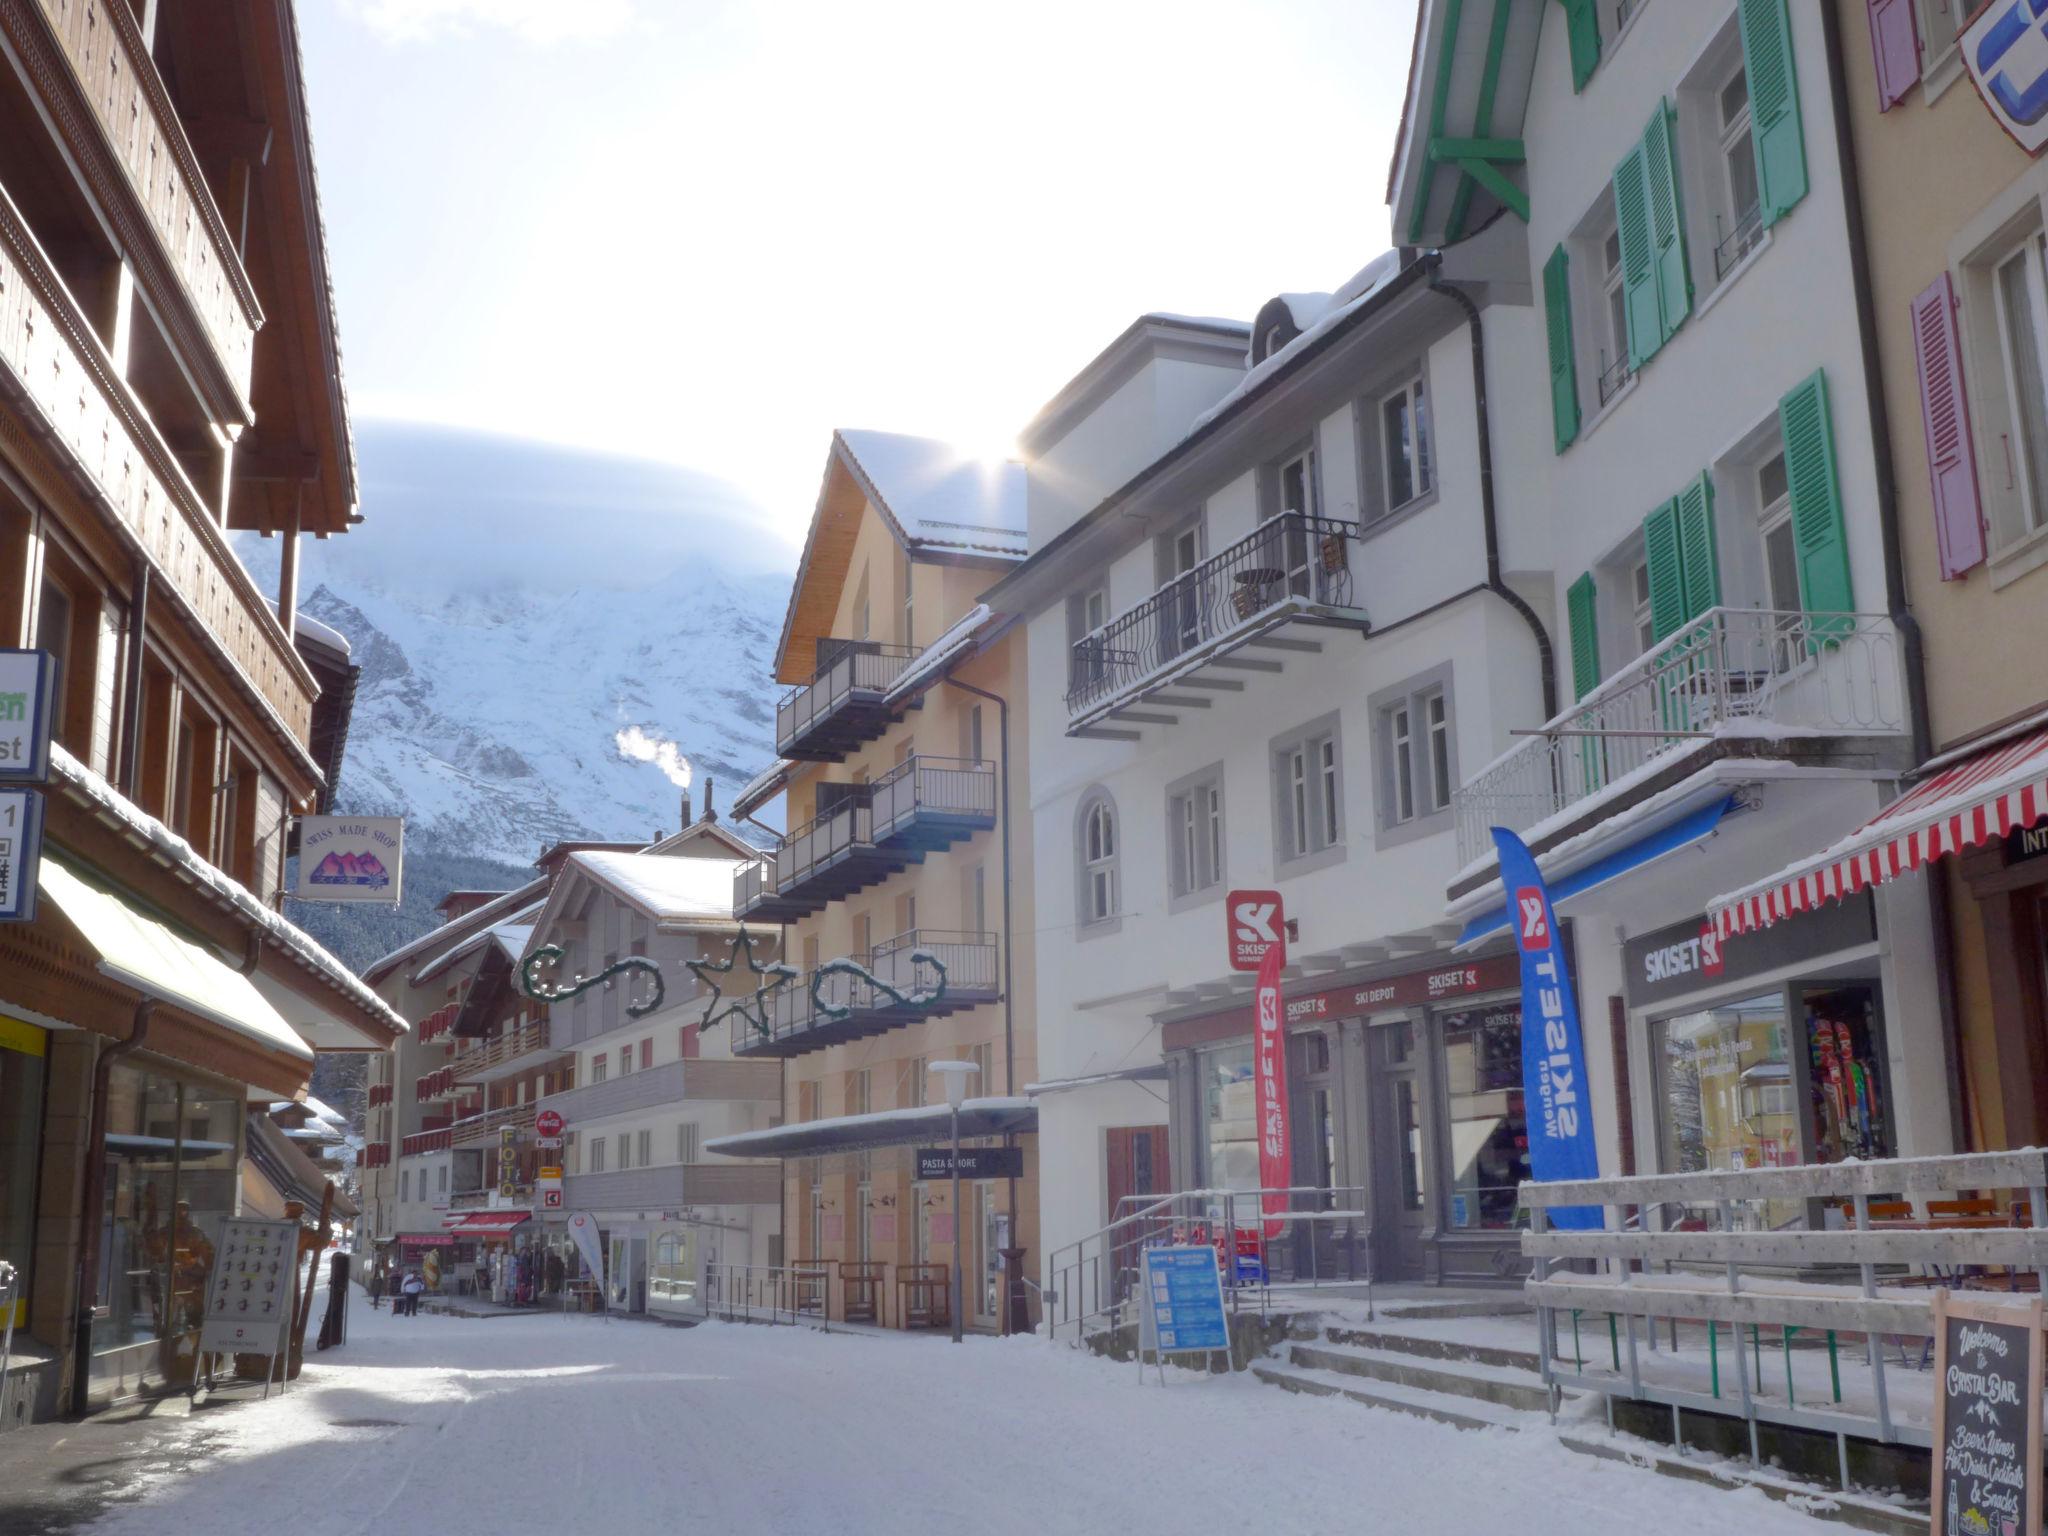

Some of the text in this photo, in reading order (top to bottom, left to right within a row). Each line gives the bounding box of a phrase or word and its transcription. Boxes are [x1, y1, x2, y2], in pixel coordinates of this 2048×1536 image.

[306, 825, 397, 848] SWISS MADE SHOP
[1644, 938, 1701, 983] SKISET
[1355, 987, 1395, 1005] SKI DEPOT
[1428, 971, 1465, 990] SKISET
[1287, 999, 1317, 1017] SKISET
[1260, 1032, 1278, 1158] SKISET
[502, 1130, 515, 1197] FOTO
[922, 1159, 946, 1169] PASTA
[947, 1158, 953, 1168] &
[1959, 1323, 2009, 1358] Welcome
[1951, 1424, 2016, 1460] Beers Wines
[1944, 1446, 2025, 1490] Hot Drinks Cocktails
[1981, 1482, 2019, 1514] Snacks
